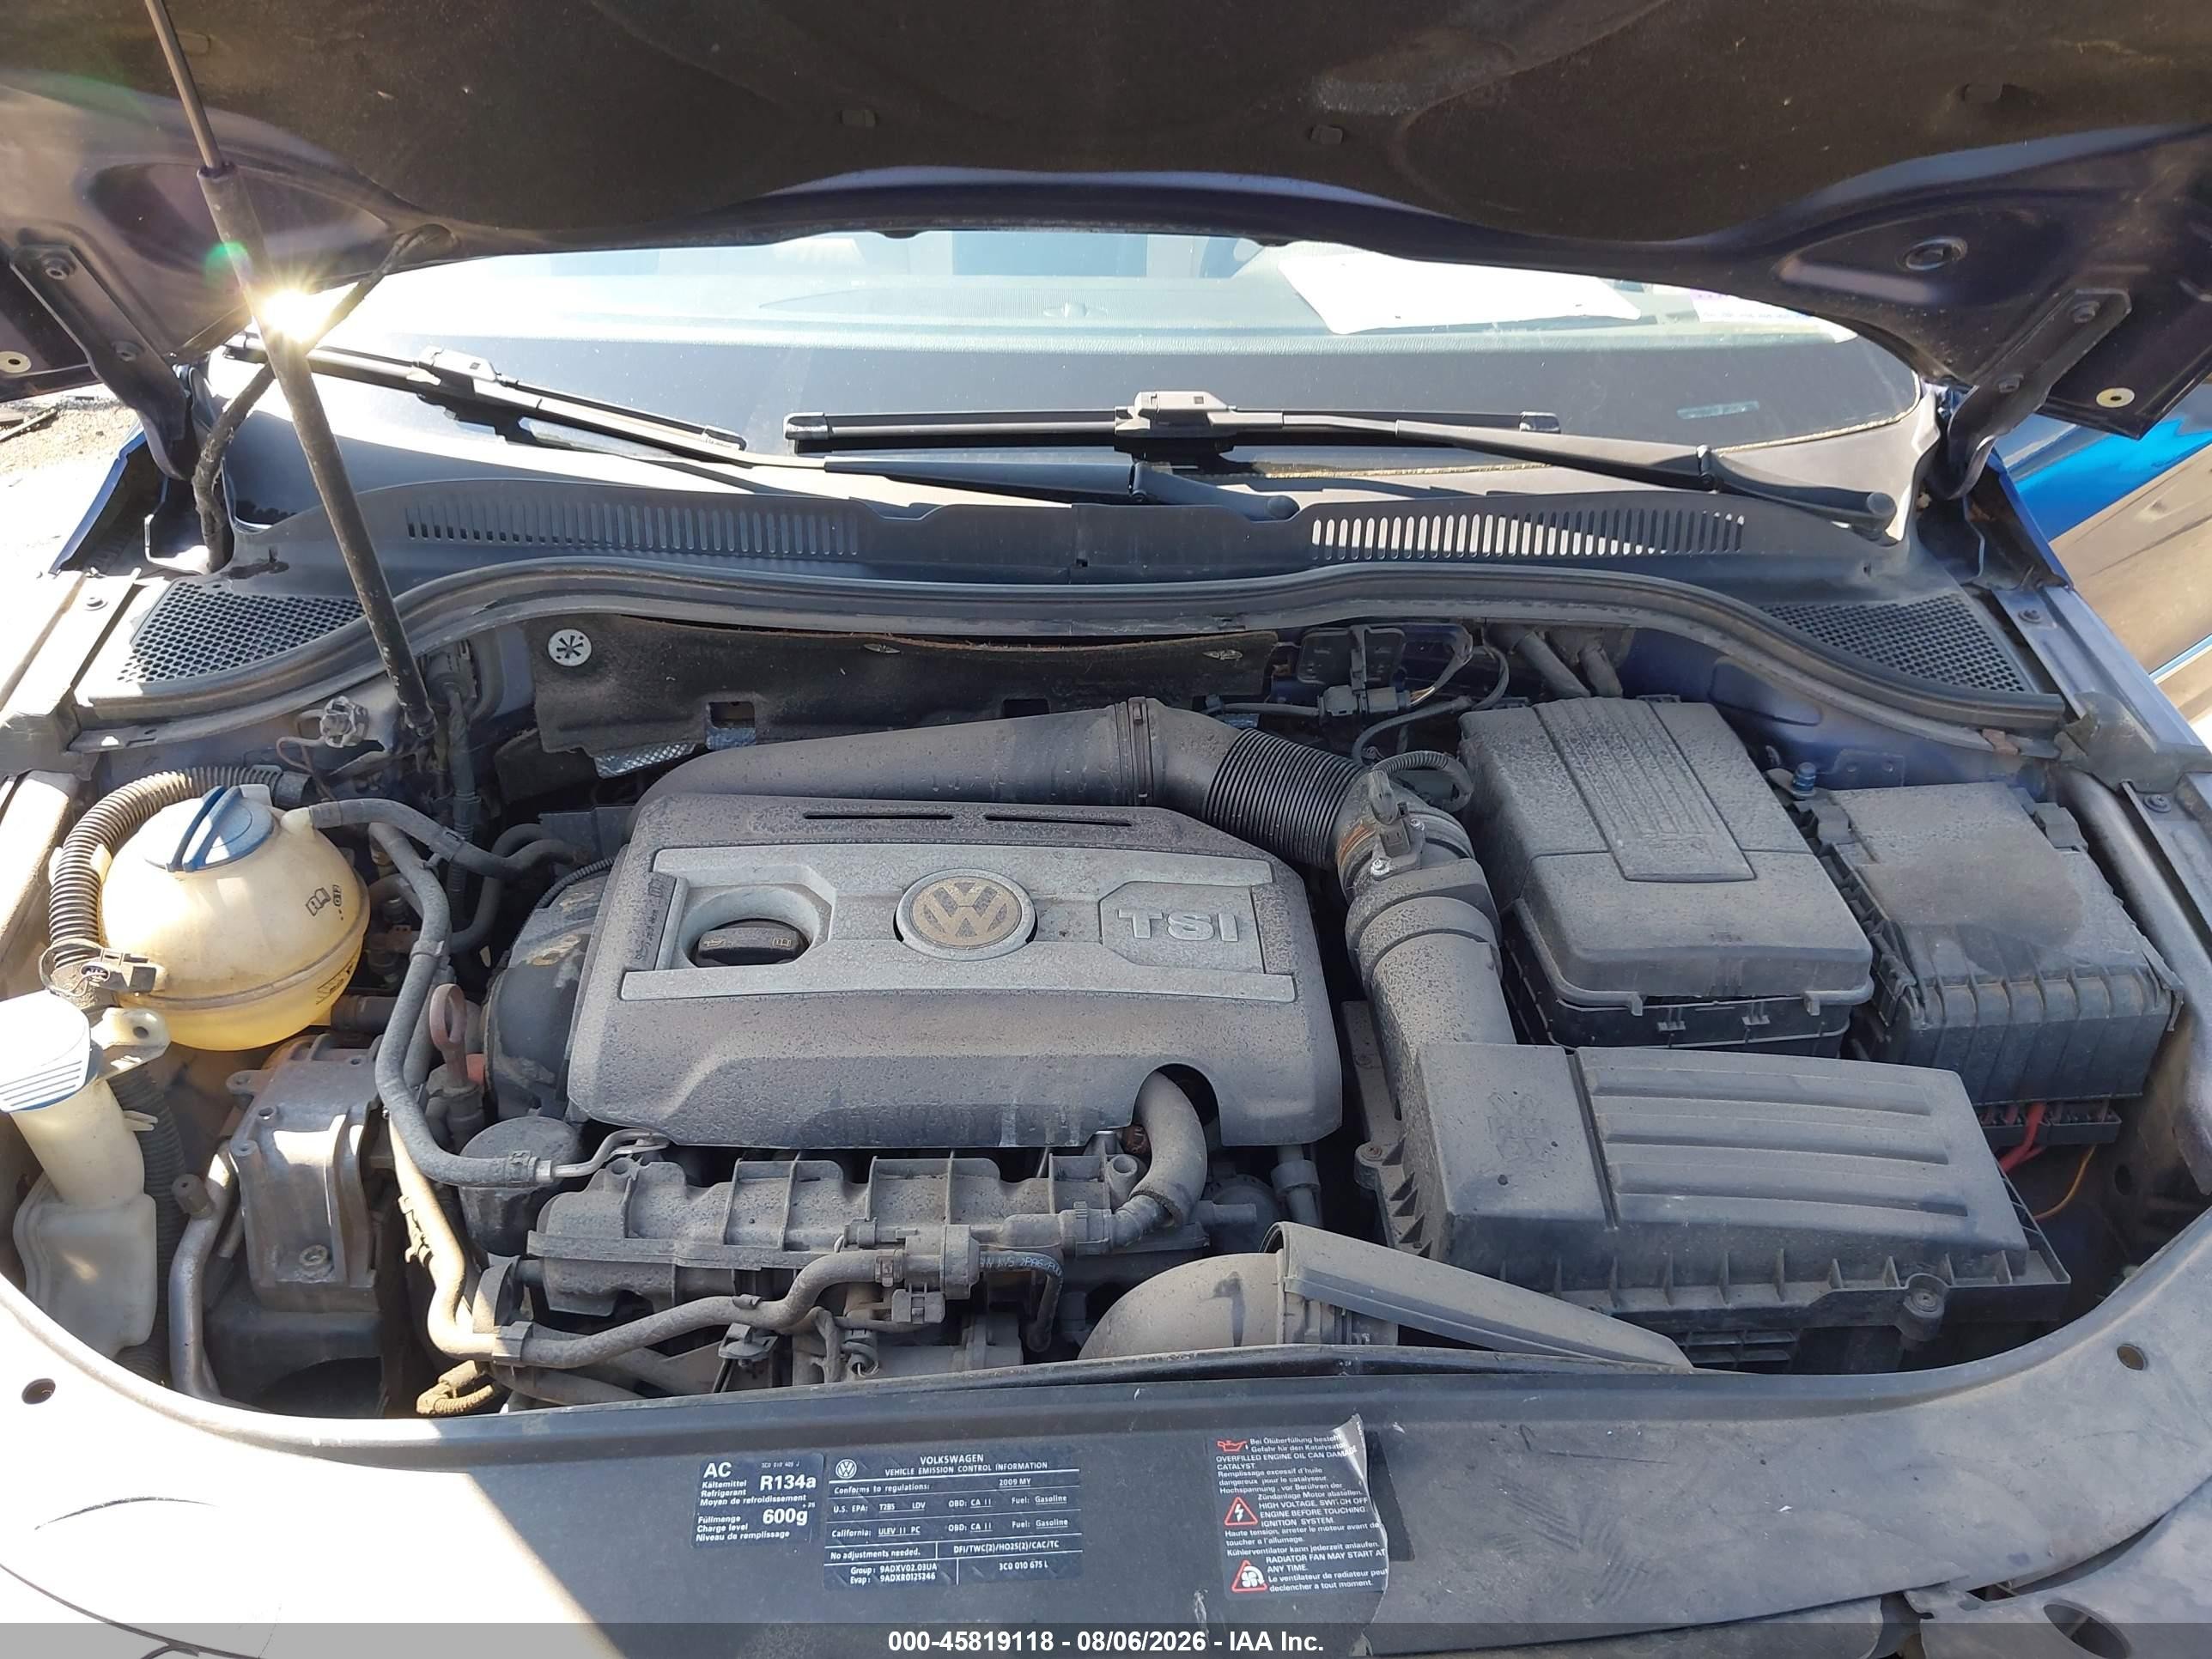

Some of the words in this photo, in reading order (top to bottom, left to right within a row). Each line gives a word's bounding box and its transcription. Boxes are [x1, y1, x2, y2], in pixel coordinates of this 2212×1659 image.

[1118, 909, 1238, 942] TSI
[1263, 1453, 1292, 1462] ENGINE
[1326, 1445, 1357, 1458] DAMAGE
[921, 1454, 984, 1465] VOLKSWAGEN
[703, 1462, 732, 1478] AC
[885, 1468, 915, 1477] VEHICLE
[918, 1466, 954, 1474] EMISSION
[957, 1464, 992, 1473] CONTROL
[995, 1462, 1048, 1471] INFORMATION
[1218, 1469, 1264, 1479] Remplissage
[1267, 1468, 1296, 1476] excessif
[702, 1480, 747, 1489] Kältemittel
[760, 1474, 817, 1491] R134a
[999, 1478, 1018, 1486] 2009
[1218, 1478, 1258, 1487] dangereux
[1295, 1483, 1329, 1492] Berühren
[701, 1488, 746, 1498] Refrigerant
[834, 1486, 870, 1494] Conforms
[885, 1483, 930, 1493] regulations:
[700, 1498, 728, 1508] Moyen
[731, 1497, 741, 1505] de
[743, 1494, 806, 1504] refroidissement
[948, 1499, 967, 1508] OBD:
[1035, 1494, 1067, 1503] Gasoline
[1257, 1492, 1301, 1502] Zündanlage
[763, 1507, 808, 1526] 600g
[1324, 1506, 1365, 1516] TOUCHING
[698, 1515, 741, 1524] Füllmenge
[1261, 1519, 1297, 1528] IGNITION
[696, 1524, 726, 1533] Charge
[729, 1522, 748, 1531] level
[831, 1528, 872, 1538] California:
[878, 1527, 896, 1535] ULEV
[911, 1525, 921, 1534] PC
[948, 1523, 967, 1532] OBD:
[970, 1522, 981, 1531] CA
[1012, 1520, 1030, 1528] Fuel:
[1036, 1518, 1068, 1527] Gasoline
[1317, 1524, 1346, 1533] moteur
[696, 1533, 725, 1541] Niveau
[740, 1529, 790, 1540] remplissage
[830, 1552, 842, 1560] No
[843, 1549, 889, 1561] adjustments
[891, 1547, 921, 1556] needed.
[1227, 1547, 1288, 1557] Kühlerventilator
[1310, 1542, 1343, 1553] jederzeit
[1345, 1541, 1380, 1550] anlaufen.
[1266, 1554, 1308, 1564] RADIATOR
[1310, 1553, 1326, 1562] FAN
[999, 1562, 1012, 1571] 3C0
[1015, 1561, 1028, 1570] 010
[1030, 1560, 1042, 1569] 675
[1279, 1573, 1321, 1583] ventilateur
[1370, 1568, 1388, 1577] peut
[1269, 1583, 1313, 1593] declencher
[1339, 1580, 1373, 1589] moment.
